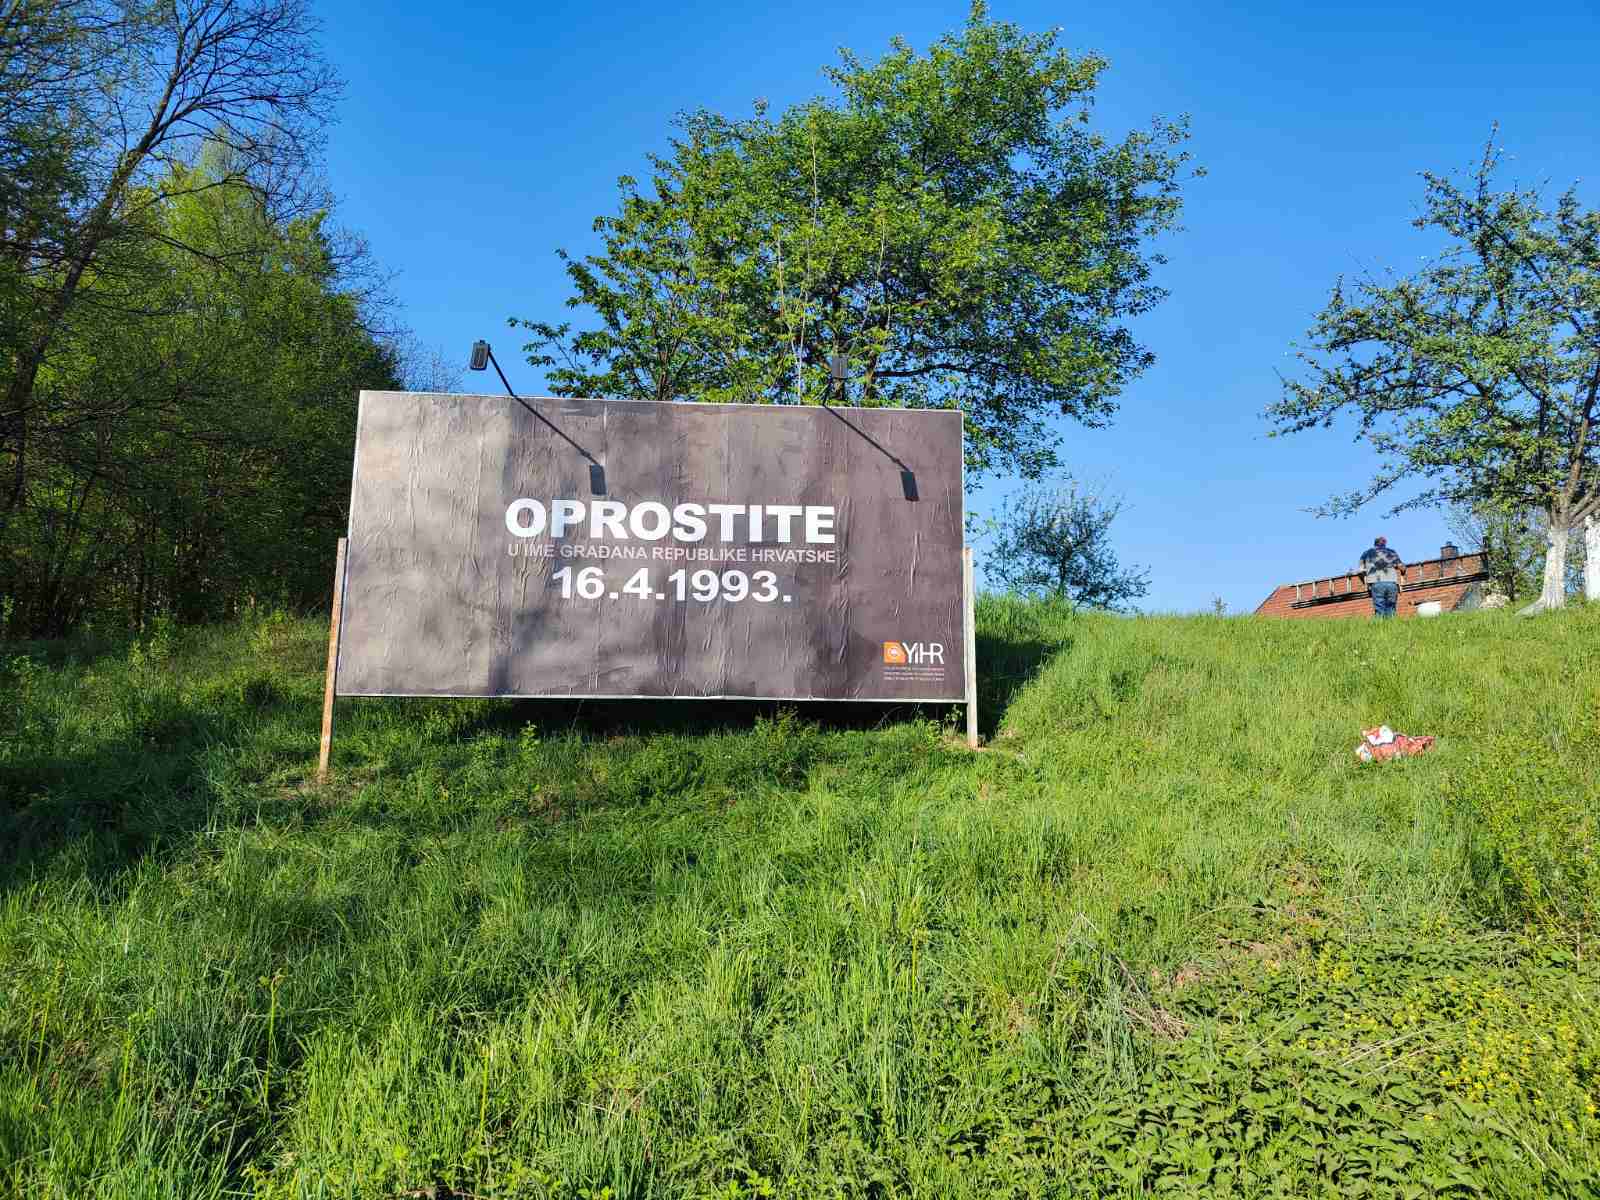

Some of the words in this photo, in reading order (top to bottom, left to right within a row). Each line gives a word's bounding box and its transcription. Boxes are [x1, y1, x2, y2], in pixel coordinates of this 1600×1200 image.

[504, 497, 836, 545] OPROSTITE
[507, 543, 519, 557] U
[524, 543, 555, 558] IME
[652, 546, 749, 562] REPUBLIKE
[752, 548, 836, 563] HRVATSKE
[552, 567, 792, 603] 16.4.1993.
